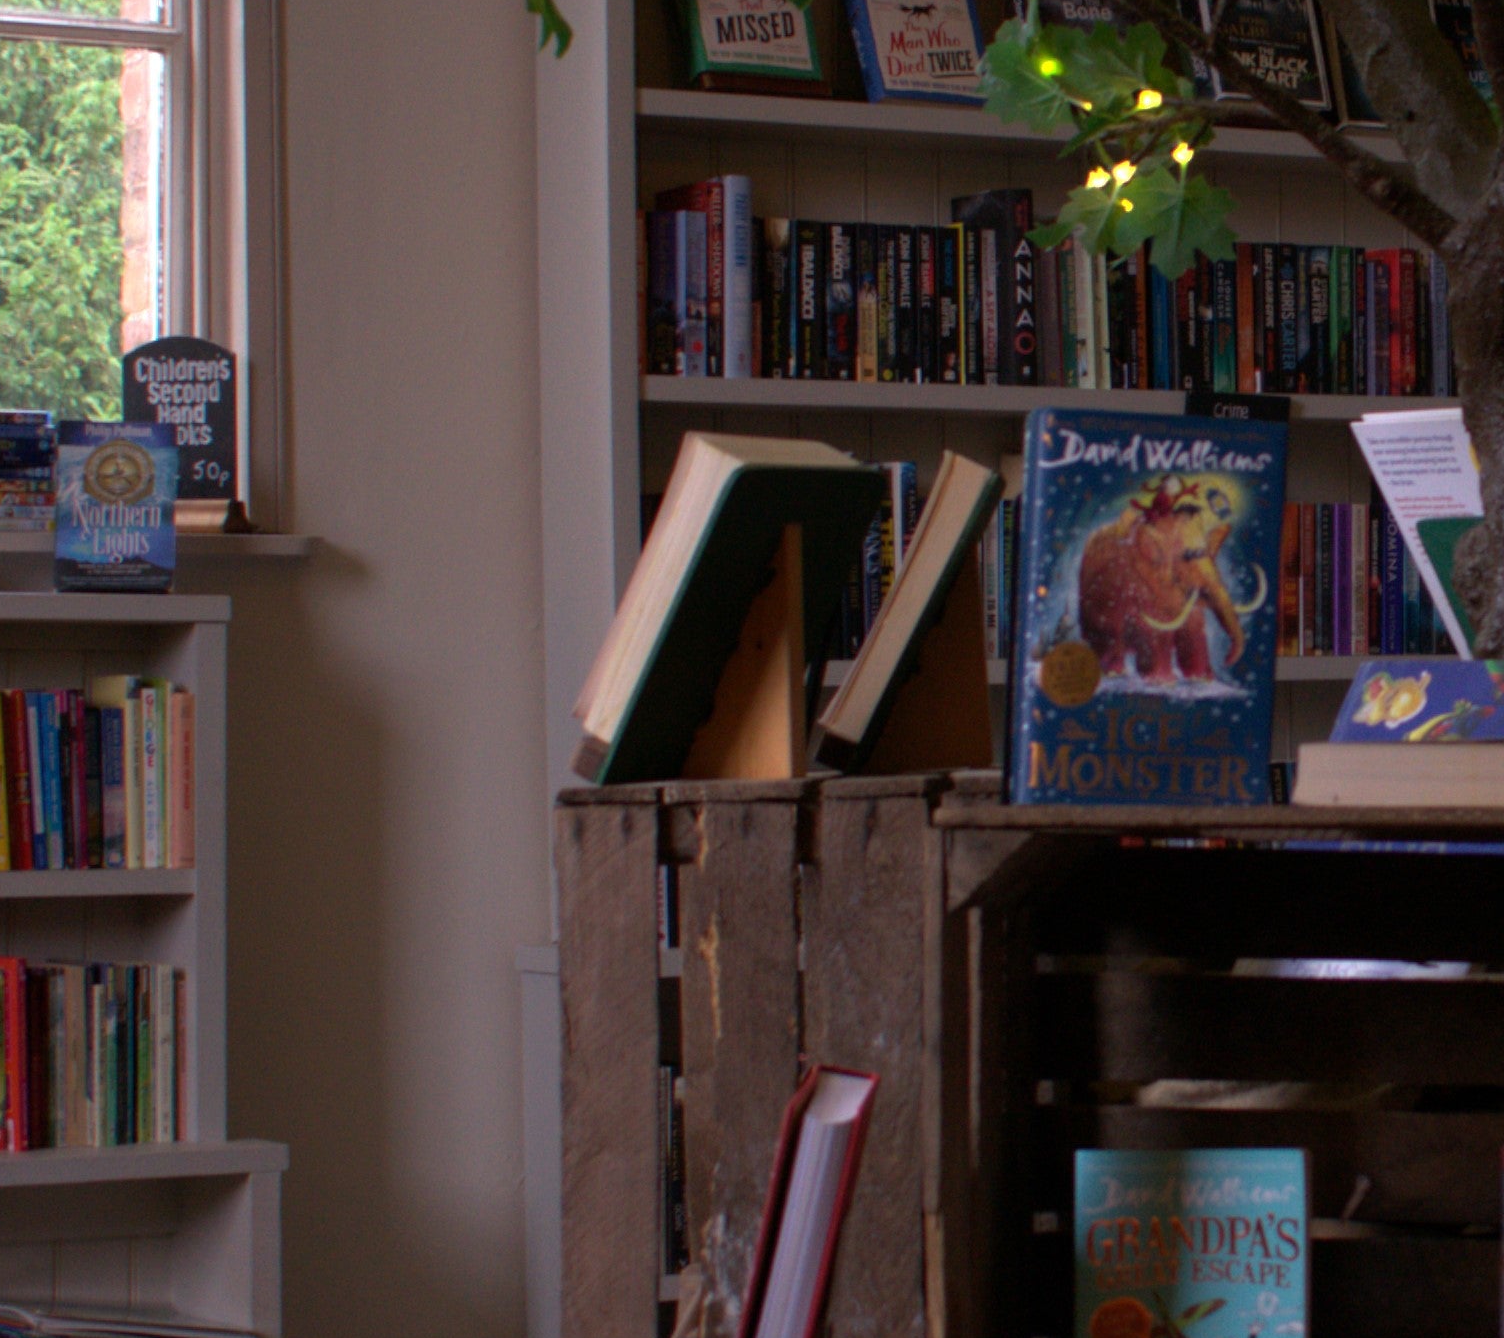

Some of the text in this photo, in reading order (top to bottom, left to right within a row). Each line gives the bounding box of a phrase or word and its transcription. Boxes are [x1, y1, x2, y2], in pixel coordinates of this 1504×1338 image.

[716, 11, 795, 45] MISSED
[890, 27, 962, 51] Man Who
[887, 51, 975, 77] Died TWICE
[1257, 52, 1309, 74] BLACK
[800, 251, 816, 320] BALDACCI
[1013, 237, 1035, 328] ANNA
[1280, 280, 1297, 371] CHRIS CARTER
[134, 353, 232, 383] Children's
[147, 380, 222, 405] Second
[156, 403, 207, 424] Hand
[1213, 401, 1250, 420] Crime
[1036, 428, 1143, 469] David
[1144, 431, 1272, 472] Walliams
[192, 460, 231, 487] 50p
[71, 499, 161, 531] Northern
[92, 528, 150, 562] Lights
[1103, 707, 1186, 752] ICE
[1027, 740, 1253, 800] MONSTER
[1086, 1214, 1300, 1266] GRANDPA'S
[1096, 1260, 1294, 1291] GREAT ESCAPE
